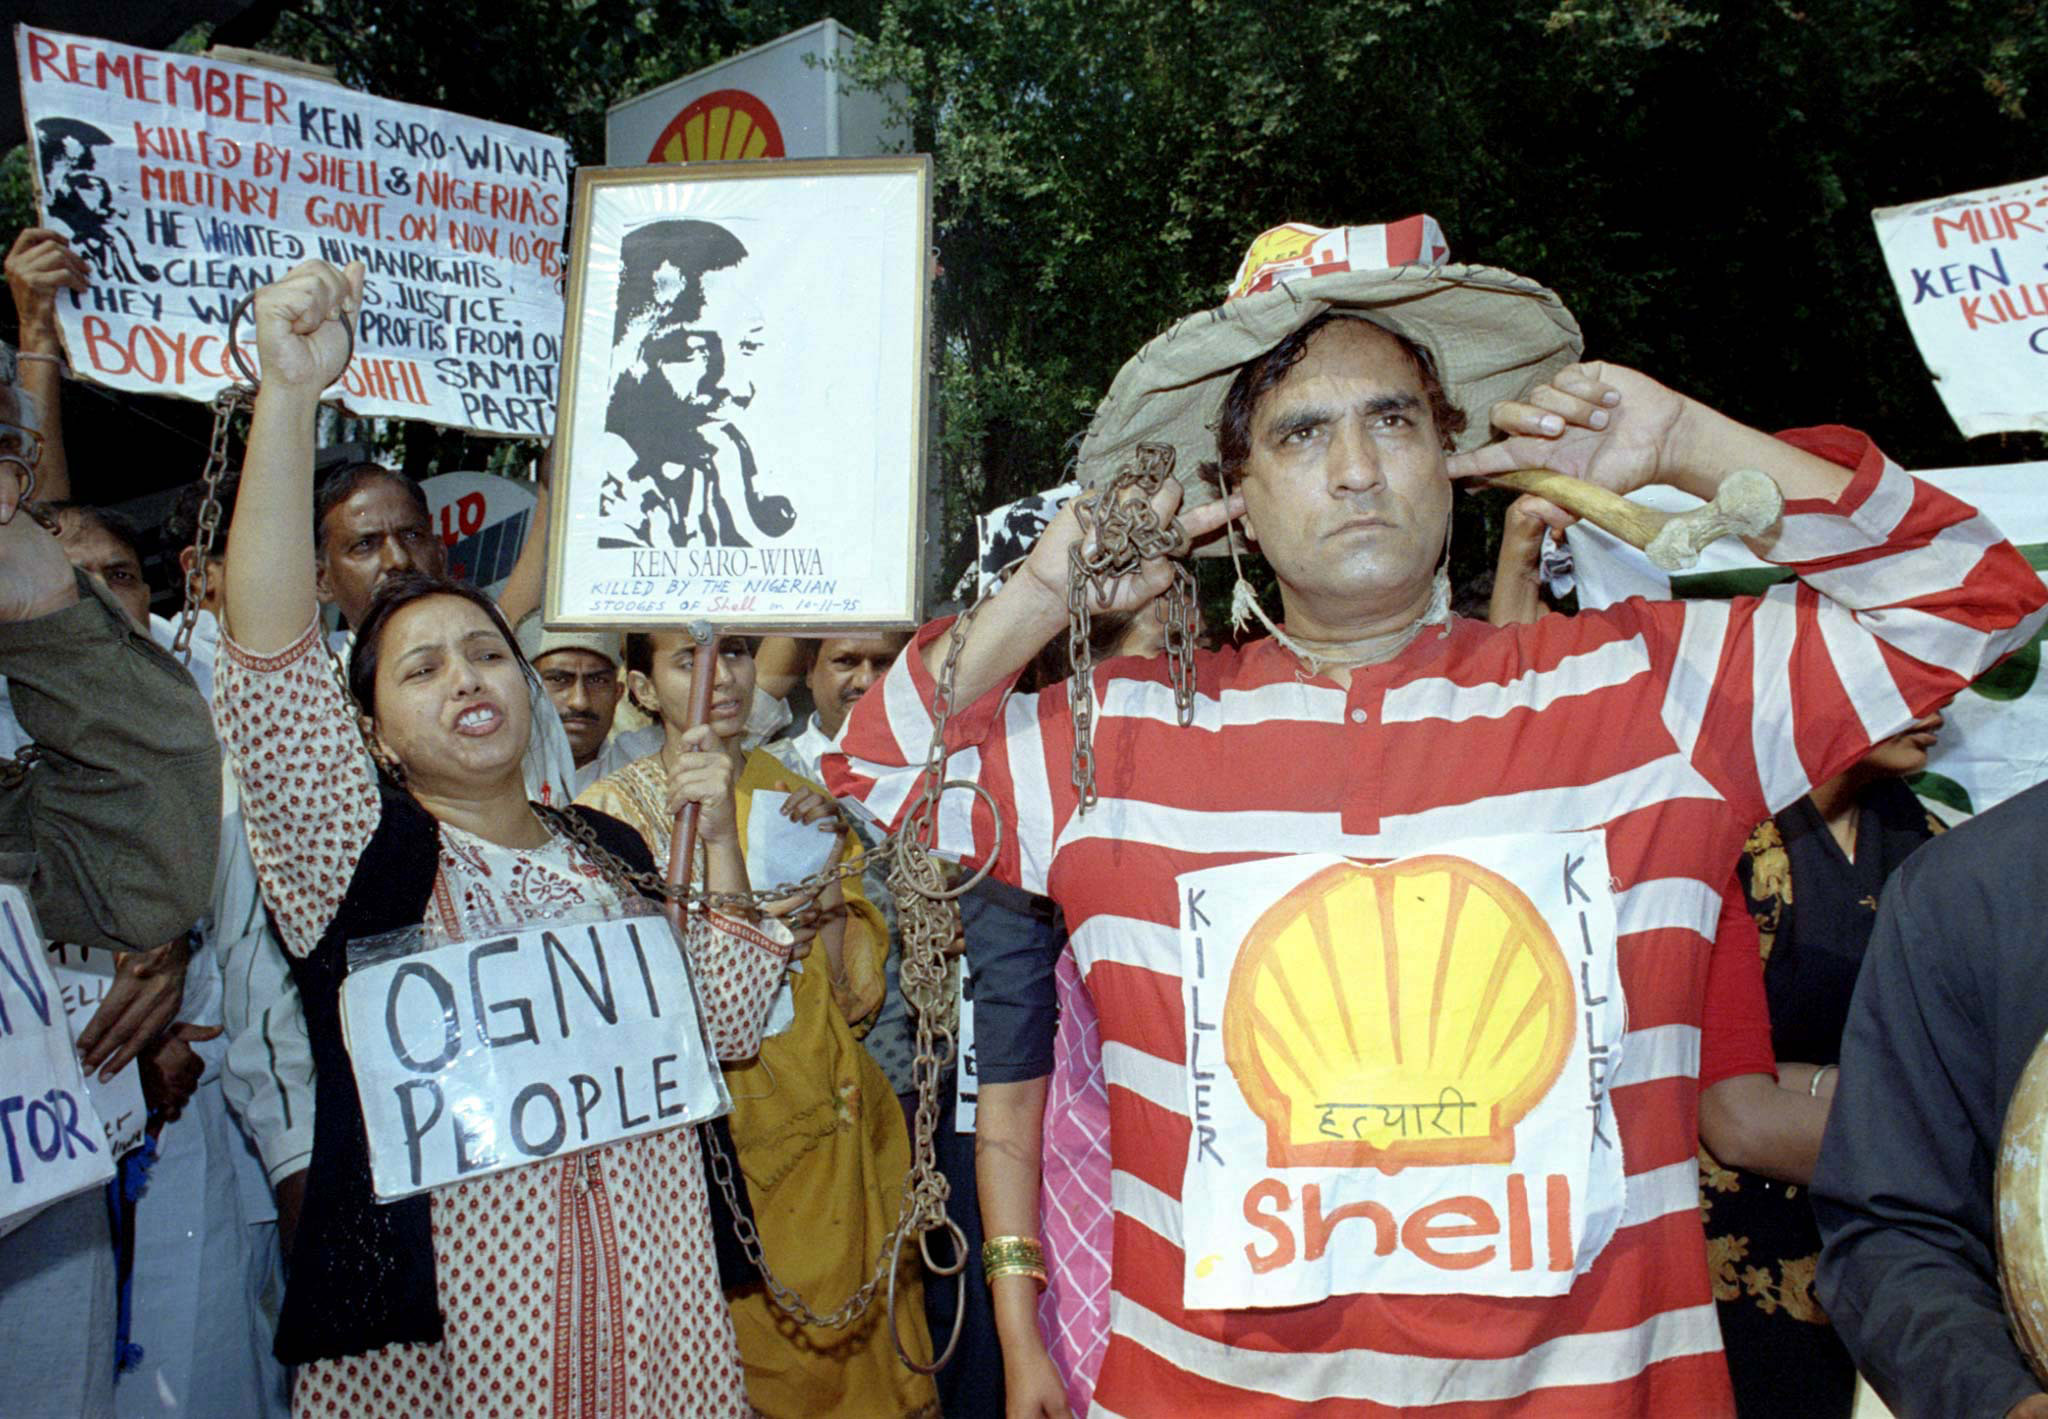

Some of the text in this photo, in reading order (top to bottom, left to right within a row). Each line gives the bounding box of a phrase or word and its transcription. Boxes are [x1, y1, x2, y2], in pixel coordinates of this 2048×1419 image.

[28, 32, 291, 125] REMEMBER
[299, 101, 363, 151] KEN
[134, 121, 241, 169] KILLED
[254, 141, 290, 183] BY
[298, 152, 387, 198] SHELL
[416, 170, 560, 226] NIGERIA'S
[140, 165, 278, 220] MILITARY
[400, 213, 436, 241] ON
[145, 208, 187, 248] HE
[196, 217, 305, 259] WANTED
[1932, 196, 2048, 249] MUR
[163, 258, 275, 292] CLEAN
[1910, 247, 2011, 305] KEN
[69, 284, 163, 322] THEY
[360, 310, 447, 351] PROFITS
[455, 327, 524, 360] FROM
[83, 315, 258, 384] BOYCO
[461, 392, 557, 436] PART
[591, 578, 837, 597] KILLED BY THE NIGERIAN
[632, 548, 824, 578] KEN SARO-WIWA
[590, 600, 666, 612] STOOGES
[679, 600, 701, 611] OF
[706, 596, 757, 613] Shell
[385, 923, 661, 1074] OGNI
[1187, 887, 1225, 1167] KILLER
[394, 1054, 687, 1186] PEOPLE
[1243, 1173, 1574, 1275] Shell
